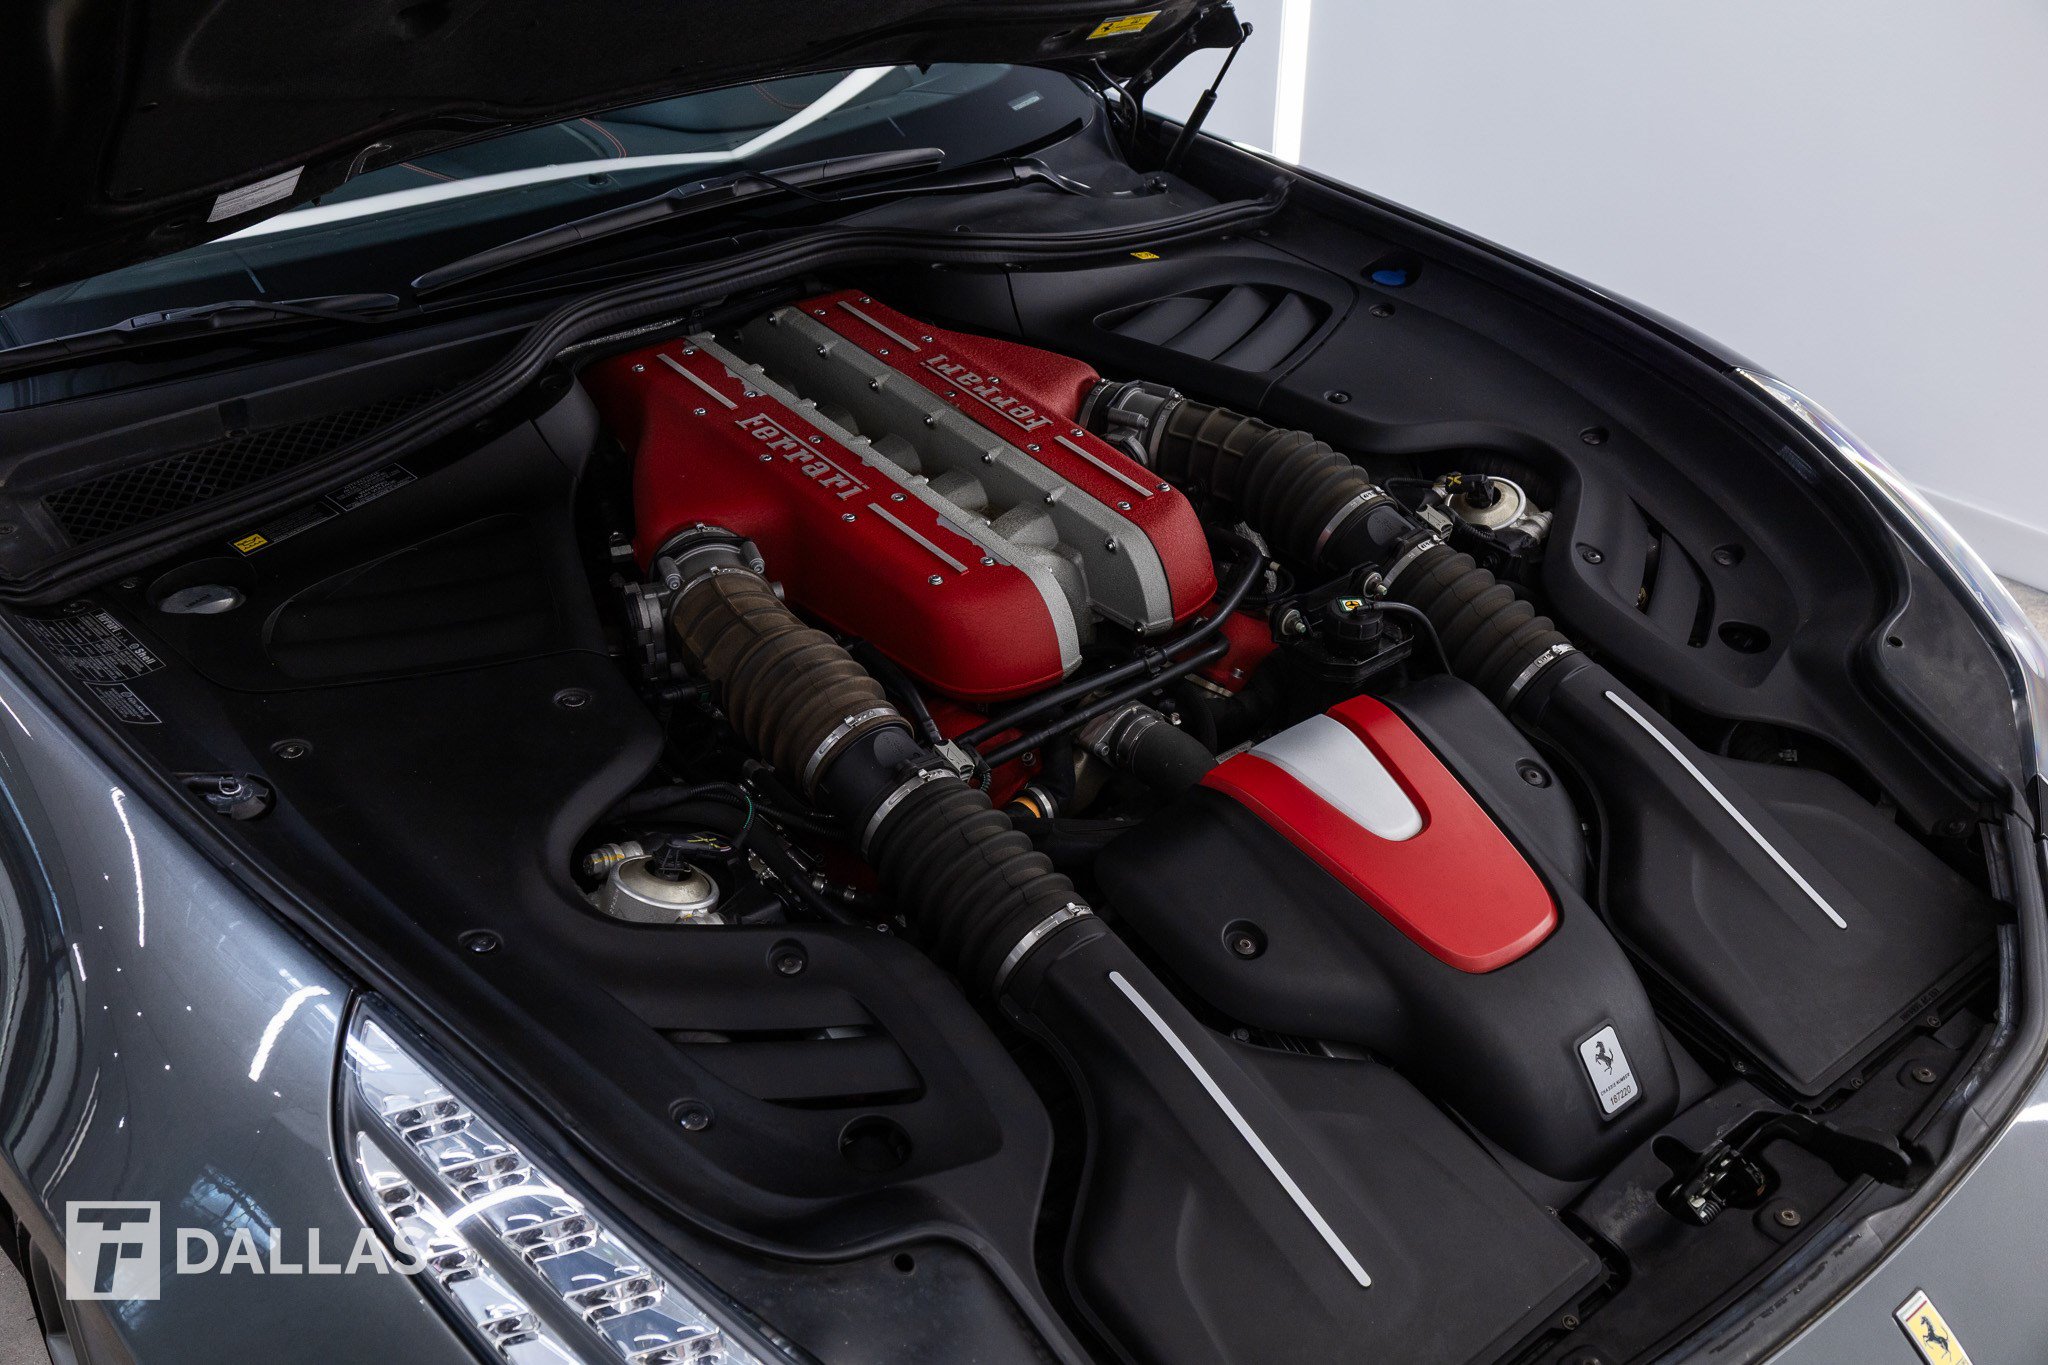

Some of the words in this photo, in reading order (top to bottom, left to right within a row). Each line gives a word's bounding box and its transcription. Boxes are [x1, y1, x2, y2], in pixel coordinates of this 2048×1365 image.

[919, 353, 1053, 432] Ferrari
[734, 412, 870, 501] Ferrari
[134, 648, 156, 665] Shell
[1600, 1082, 1617, 1096] CHASSIS
[1616, 1072, 1630, 1085] NUMBER
[1610, 1084, 1632, 1105] 187220
